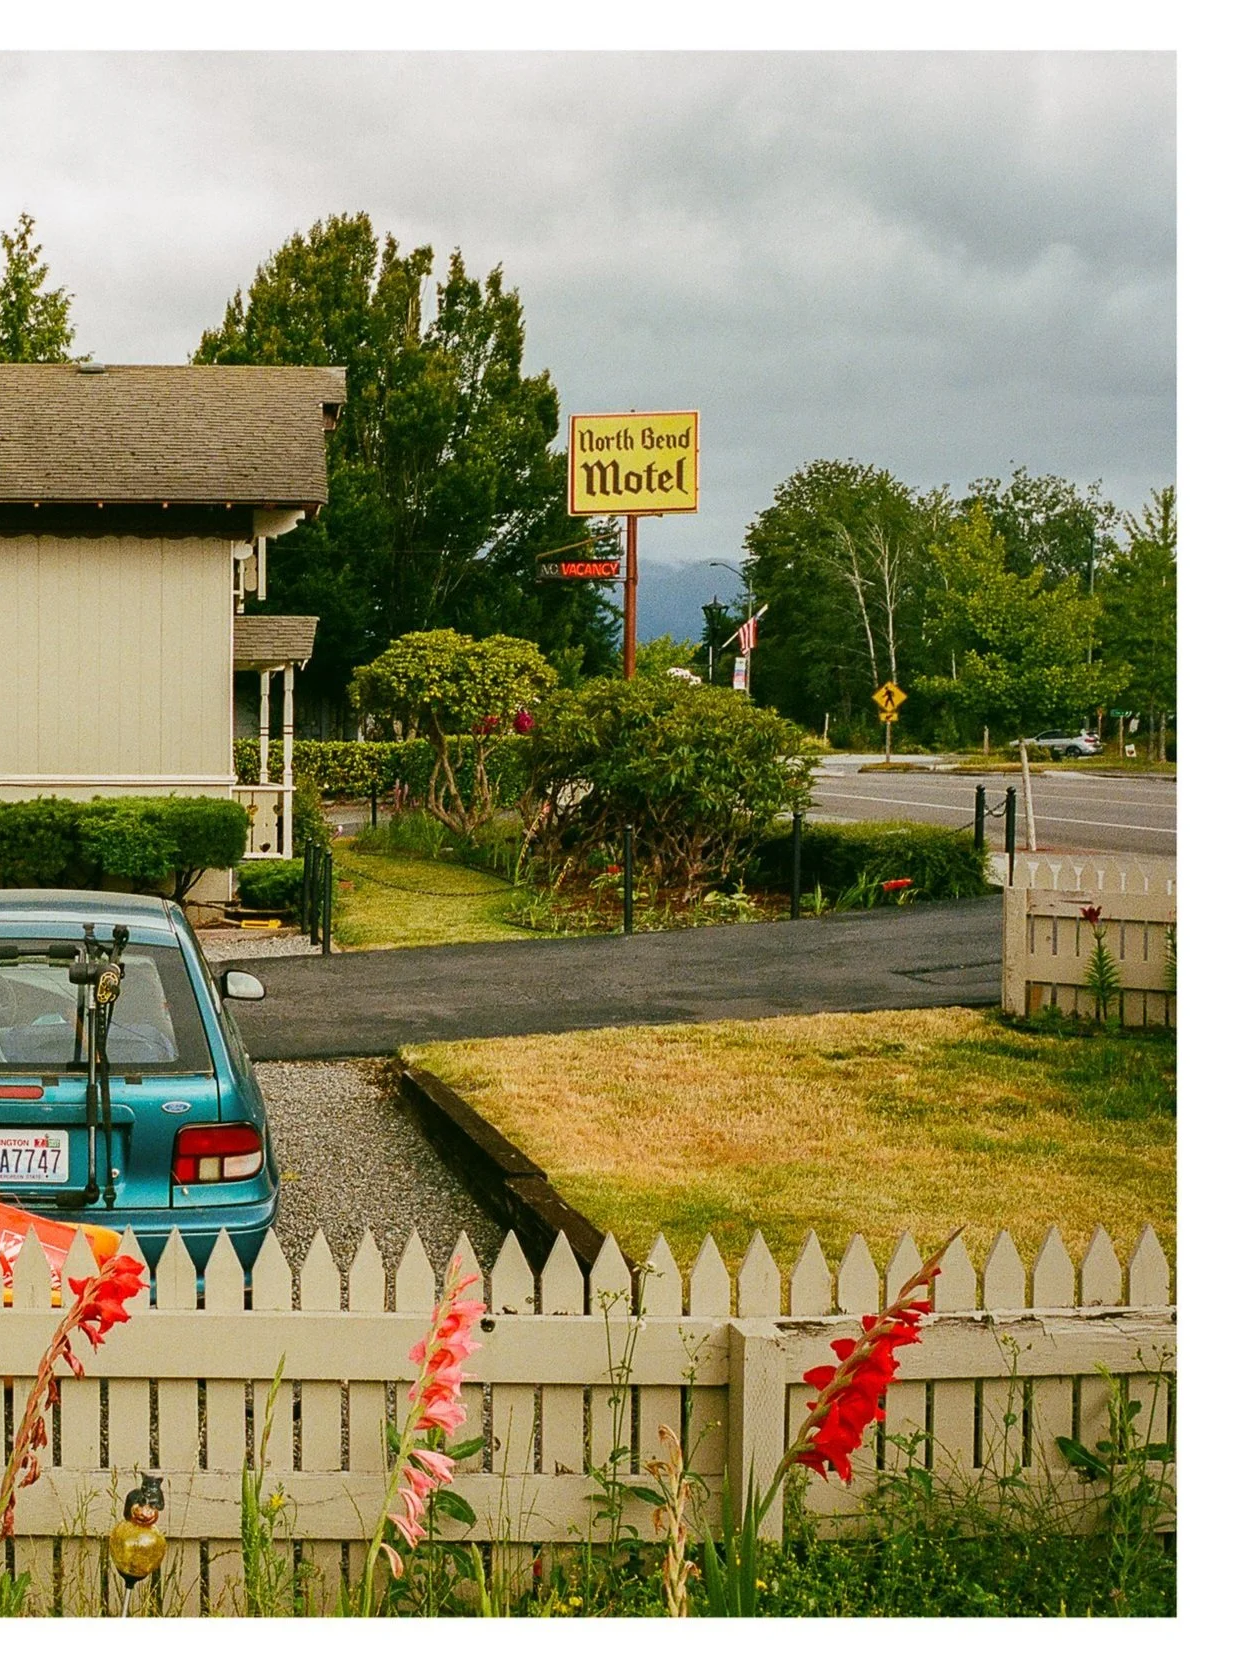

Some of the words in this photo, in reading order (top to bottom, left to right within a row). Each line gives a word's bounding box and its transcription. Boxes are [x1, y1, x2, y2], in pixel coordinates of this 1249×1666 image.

[578, 428, 634, 453] North
[641, 426, 692, 450] Bend
[580, 456, 689, 497] Motel
[541, 563, 559, 575] NO
[561, 562, 618, 576] VACANCY
